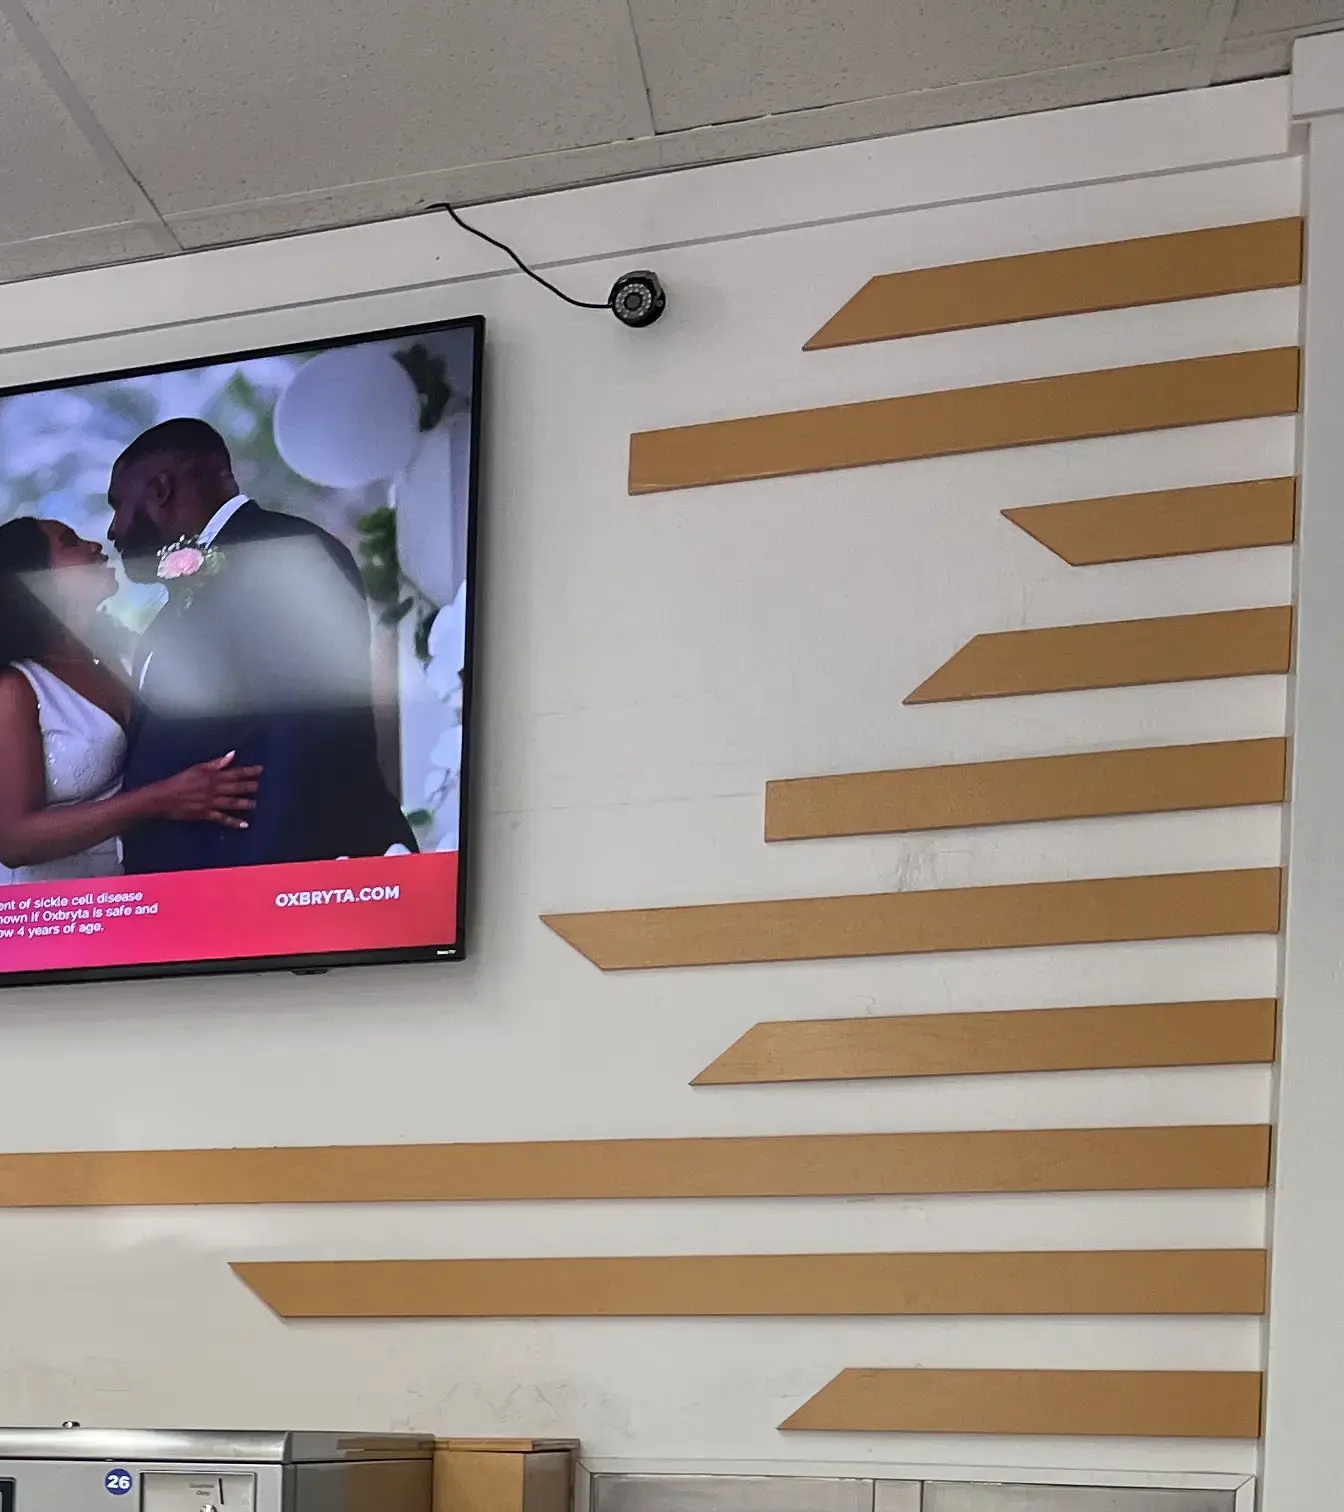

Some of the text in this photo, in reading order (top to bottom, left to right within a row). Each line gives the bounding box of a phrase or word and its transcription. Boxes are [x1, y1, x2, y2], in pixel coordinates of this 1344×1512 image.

[18, 898, 32, 911] of
[33, 897, 69, 909] sickle
[71, 894, 93, 906] cell
[96, 891, 144, 905] disease
[275, 885, 401, 907] OXBRYTA.COM
[31, 911, 40, 923] if
[42, 908, 90, 923] Oxbryta
[92, 907, 103, 918] is
[105, 904, 133, 917] safe
[135, 902, 159, 915] and
[17, 926, 25, 937] 4
[28, 924, 60, 938] years
[63, 922, 75, 934] of
[78, 922, 105, 935] age.
[107, 1474, 131, 1490] 26
